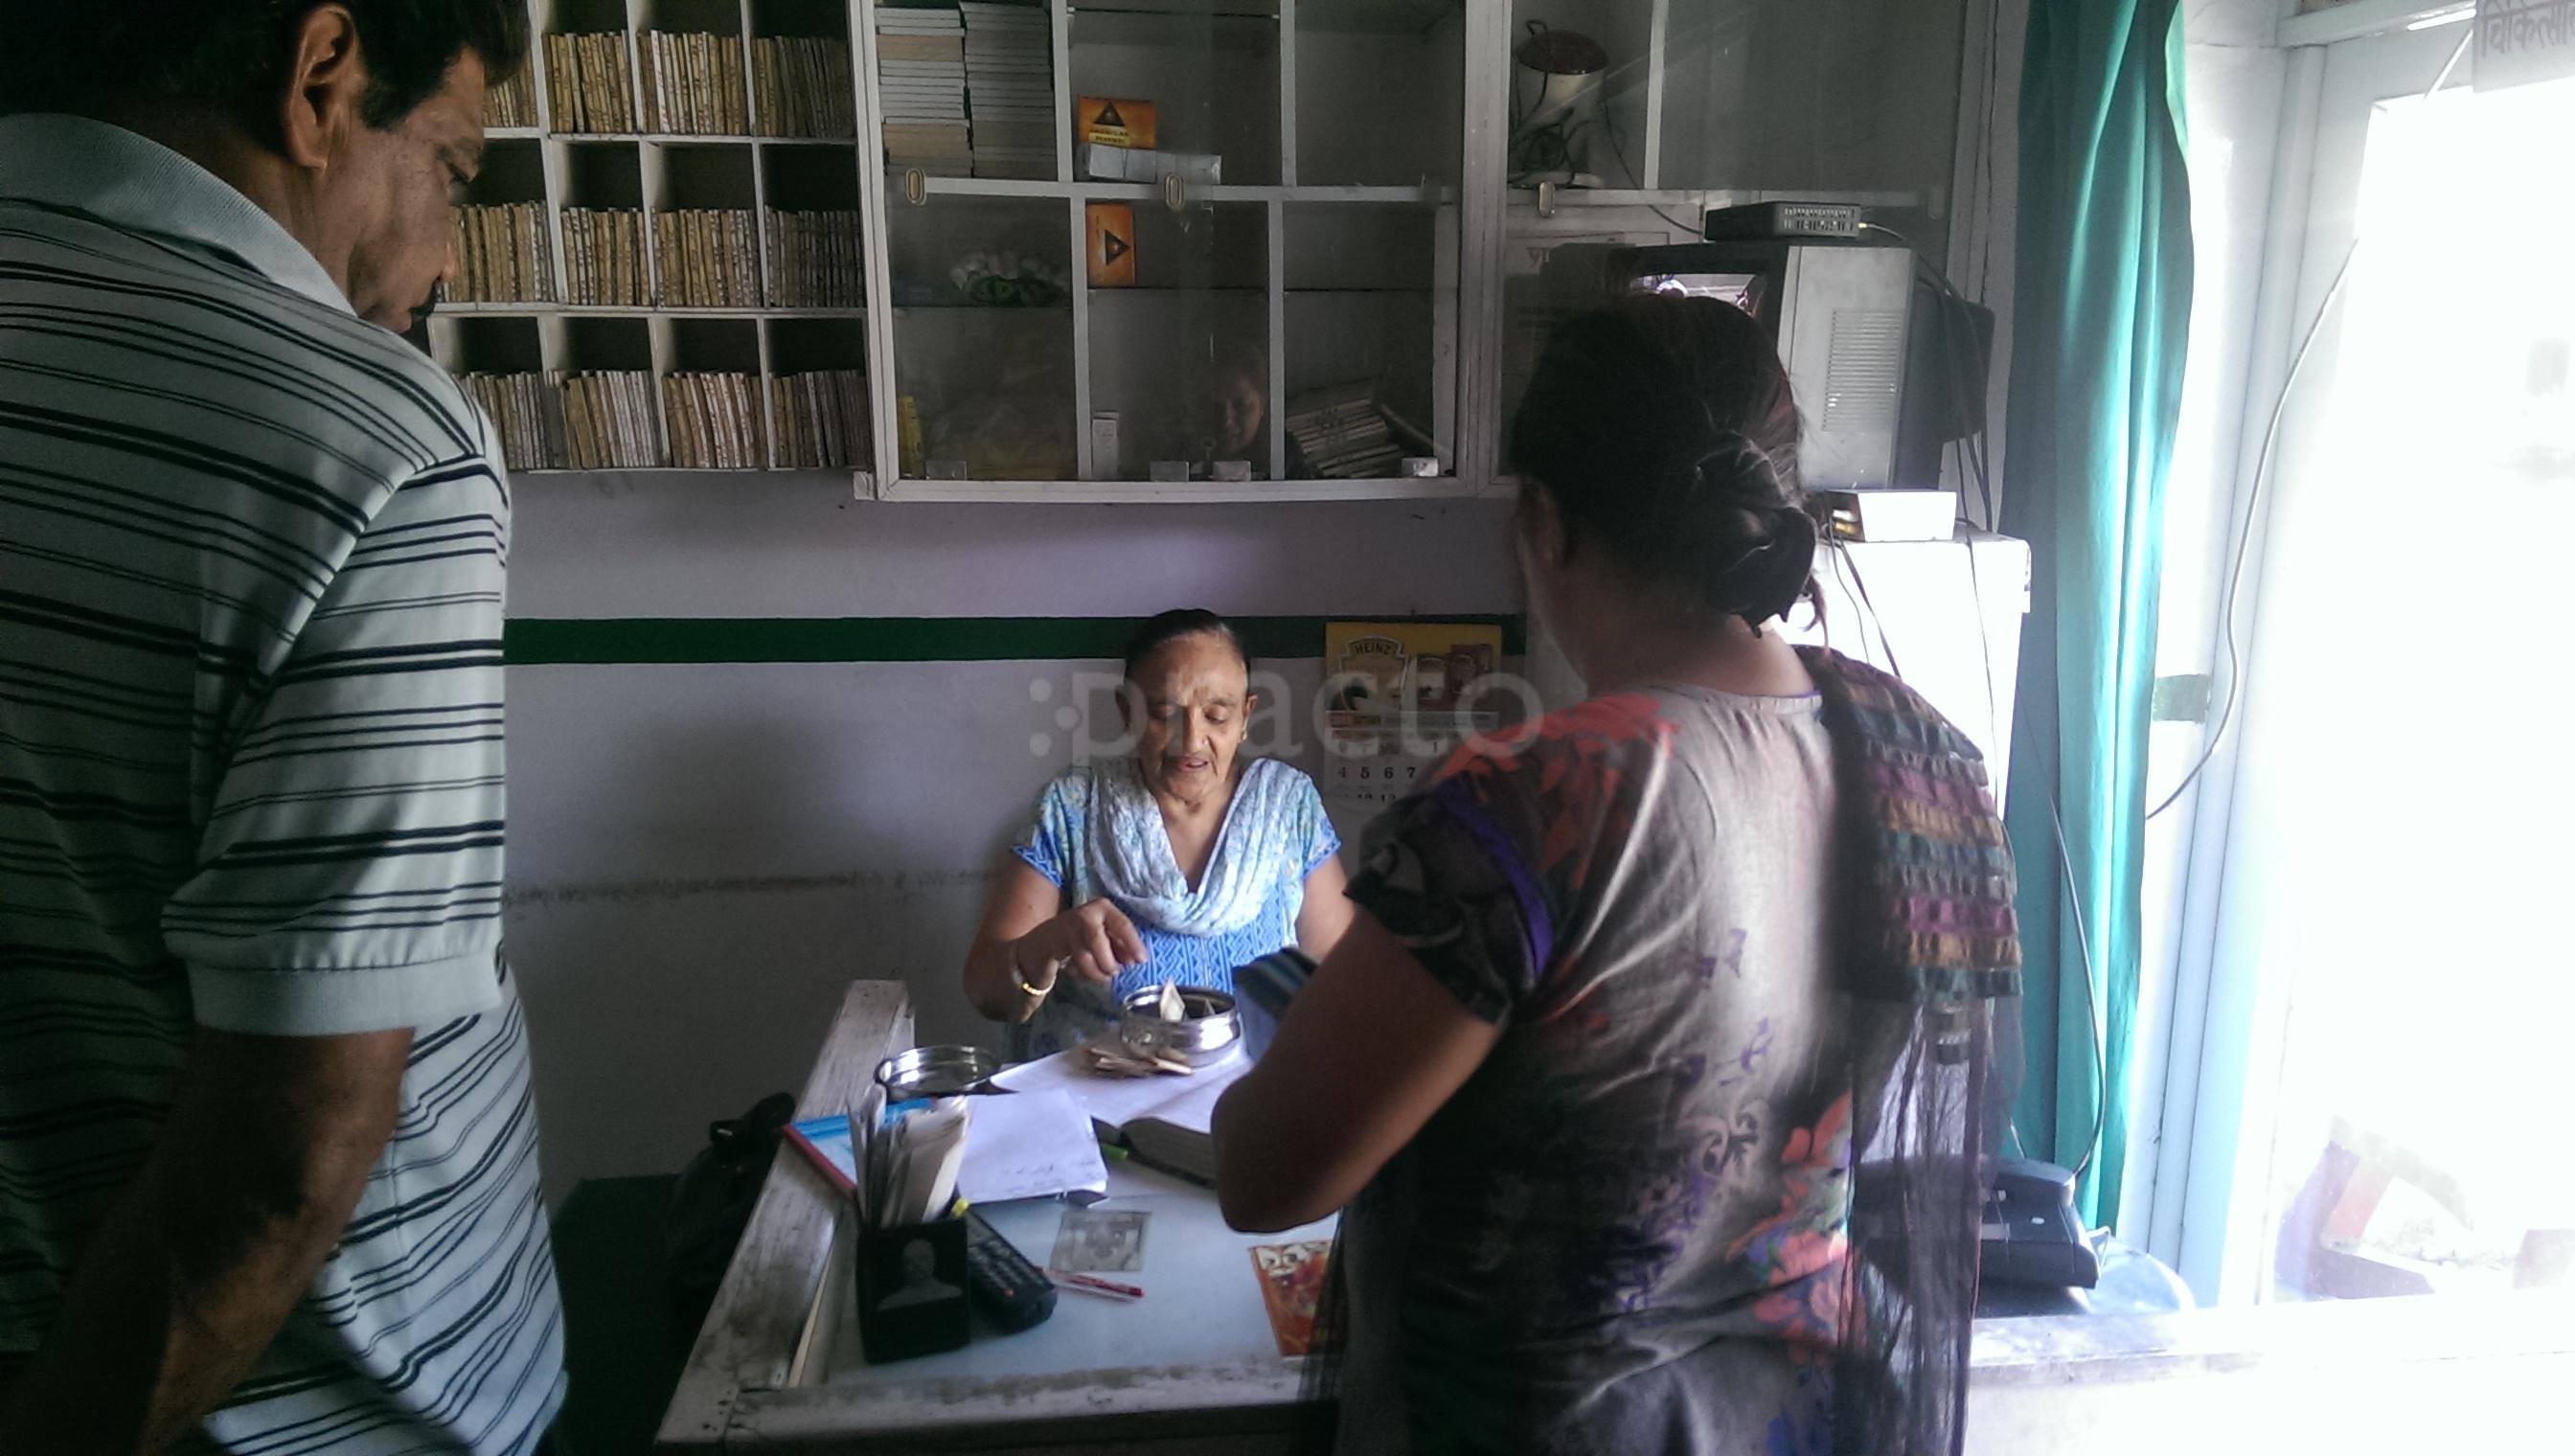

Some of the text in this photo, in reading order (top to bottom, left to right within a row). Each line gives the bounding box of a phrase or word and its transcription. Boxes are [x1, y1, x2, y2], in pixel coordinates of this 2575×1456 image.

[1355, 641, 1393, 655] HEINZ
[1360, 766, 1370, 779] 5
[1383, 766, 1394, 779] 6
[1406, 766, 1416, 779] 7
